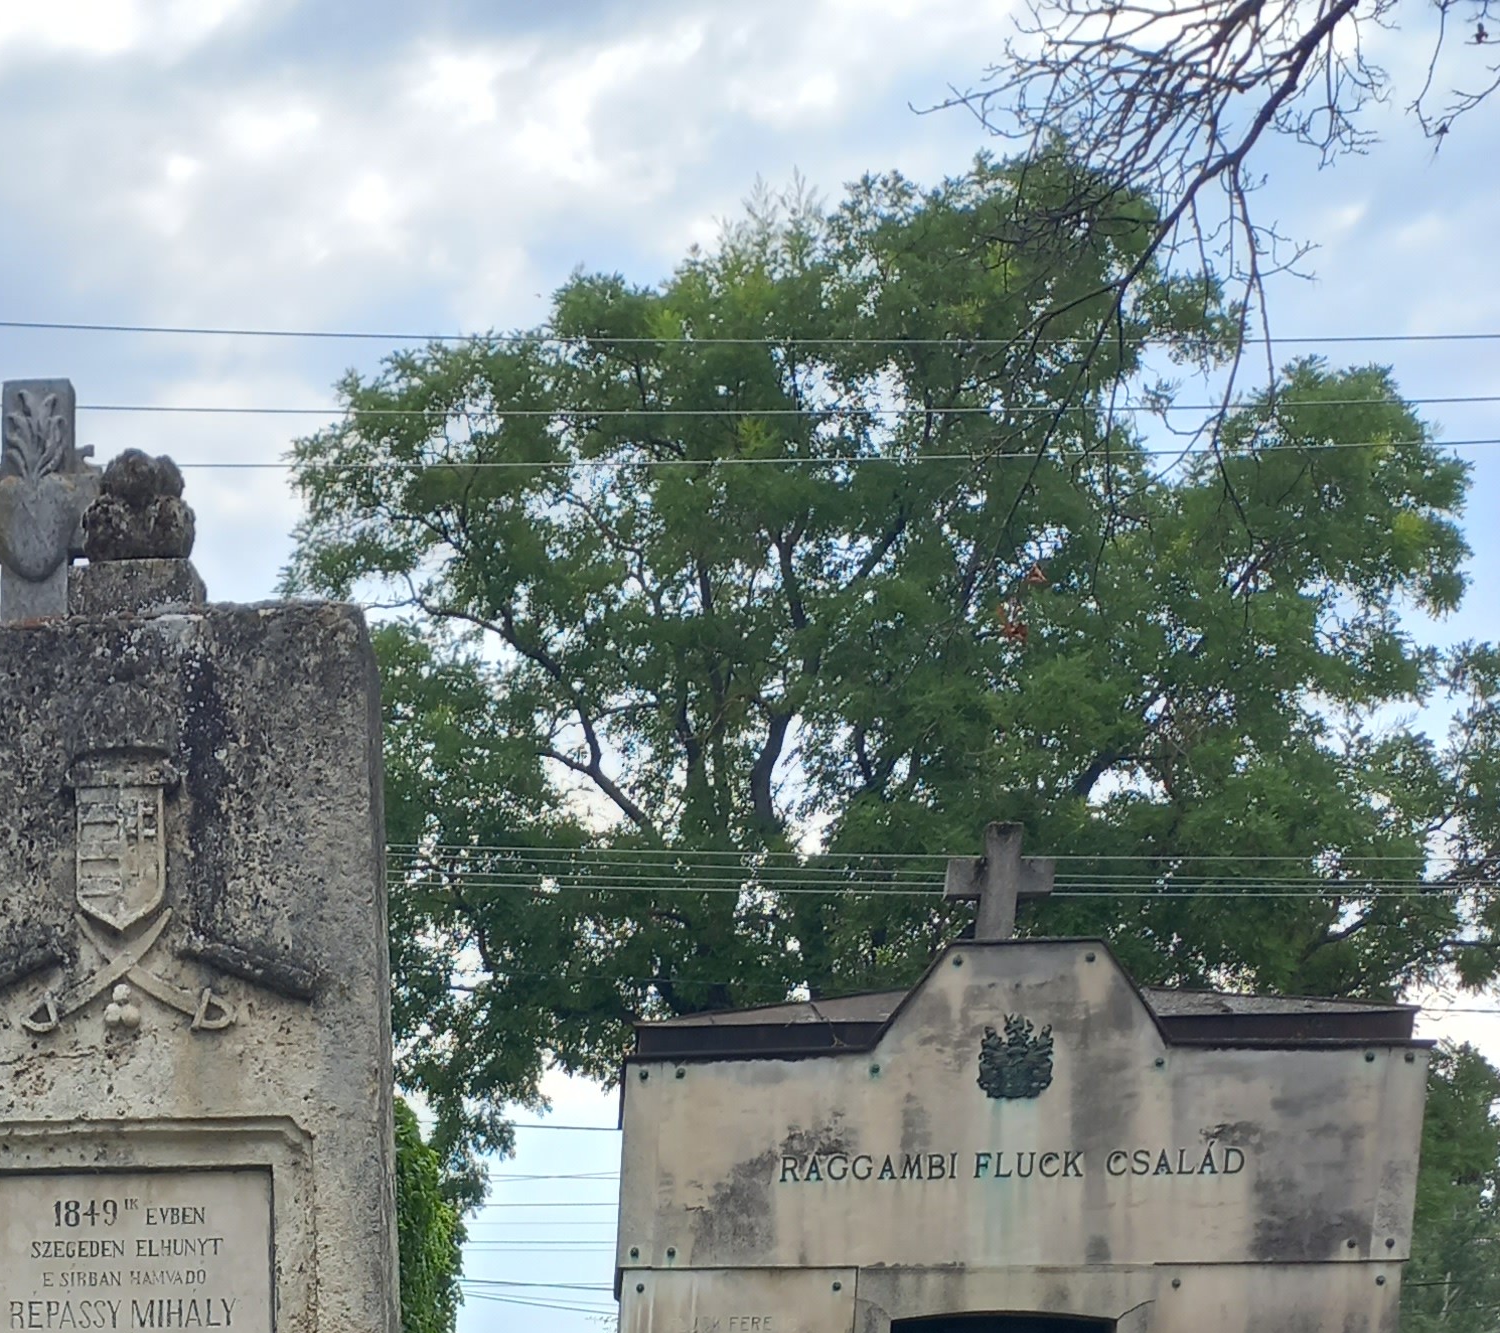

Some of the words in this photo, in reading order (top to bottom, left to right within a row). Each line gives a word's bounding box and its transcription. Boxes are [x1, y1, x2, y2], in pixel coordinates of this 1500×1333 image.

[779, 1151, 958, 1183] RAGGAMBI
[973, 1151, 1085, 1178] FLUCK
[1105, 1141, 1246, 1177] CSALÁD
[53, 1198, 119, 1228] 1849
[31, 1239, 125, 1259] SZEGEDEN
[135, 1237, 224, 1257] ELHUNYT
[43, 1272, 54, 1287] E
[9, 1290, 122, 1329] RÉPÁSSY
[131, 1288, 237, 1328] MIHÁLY
